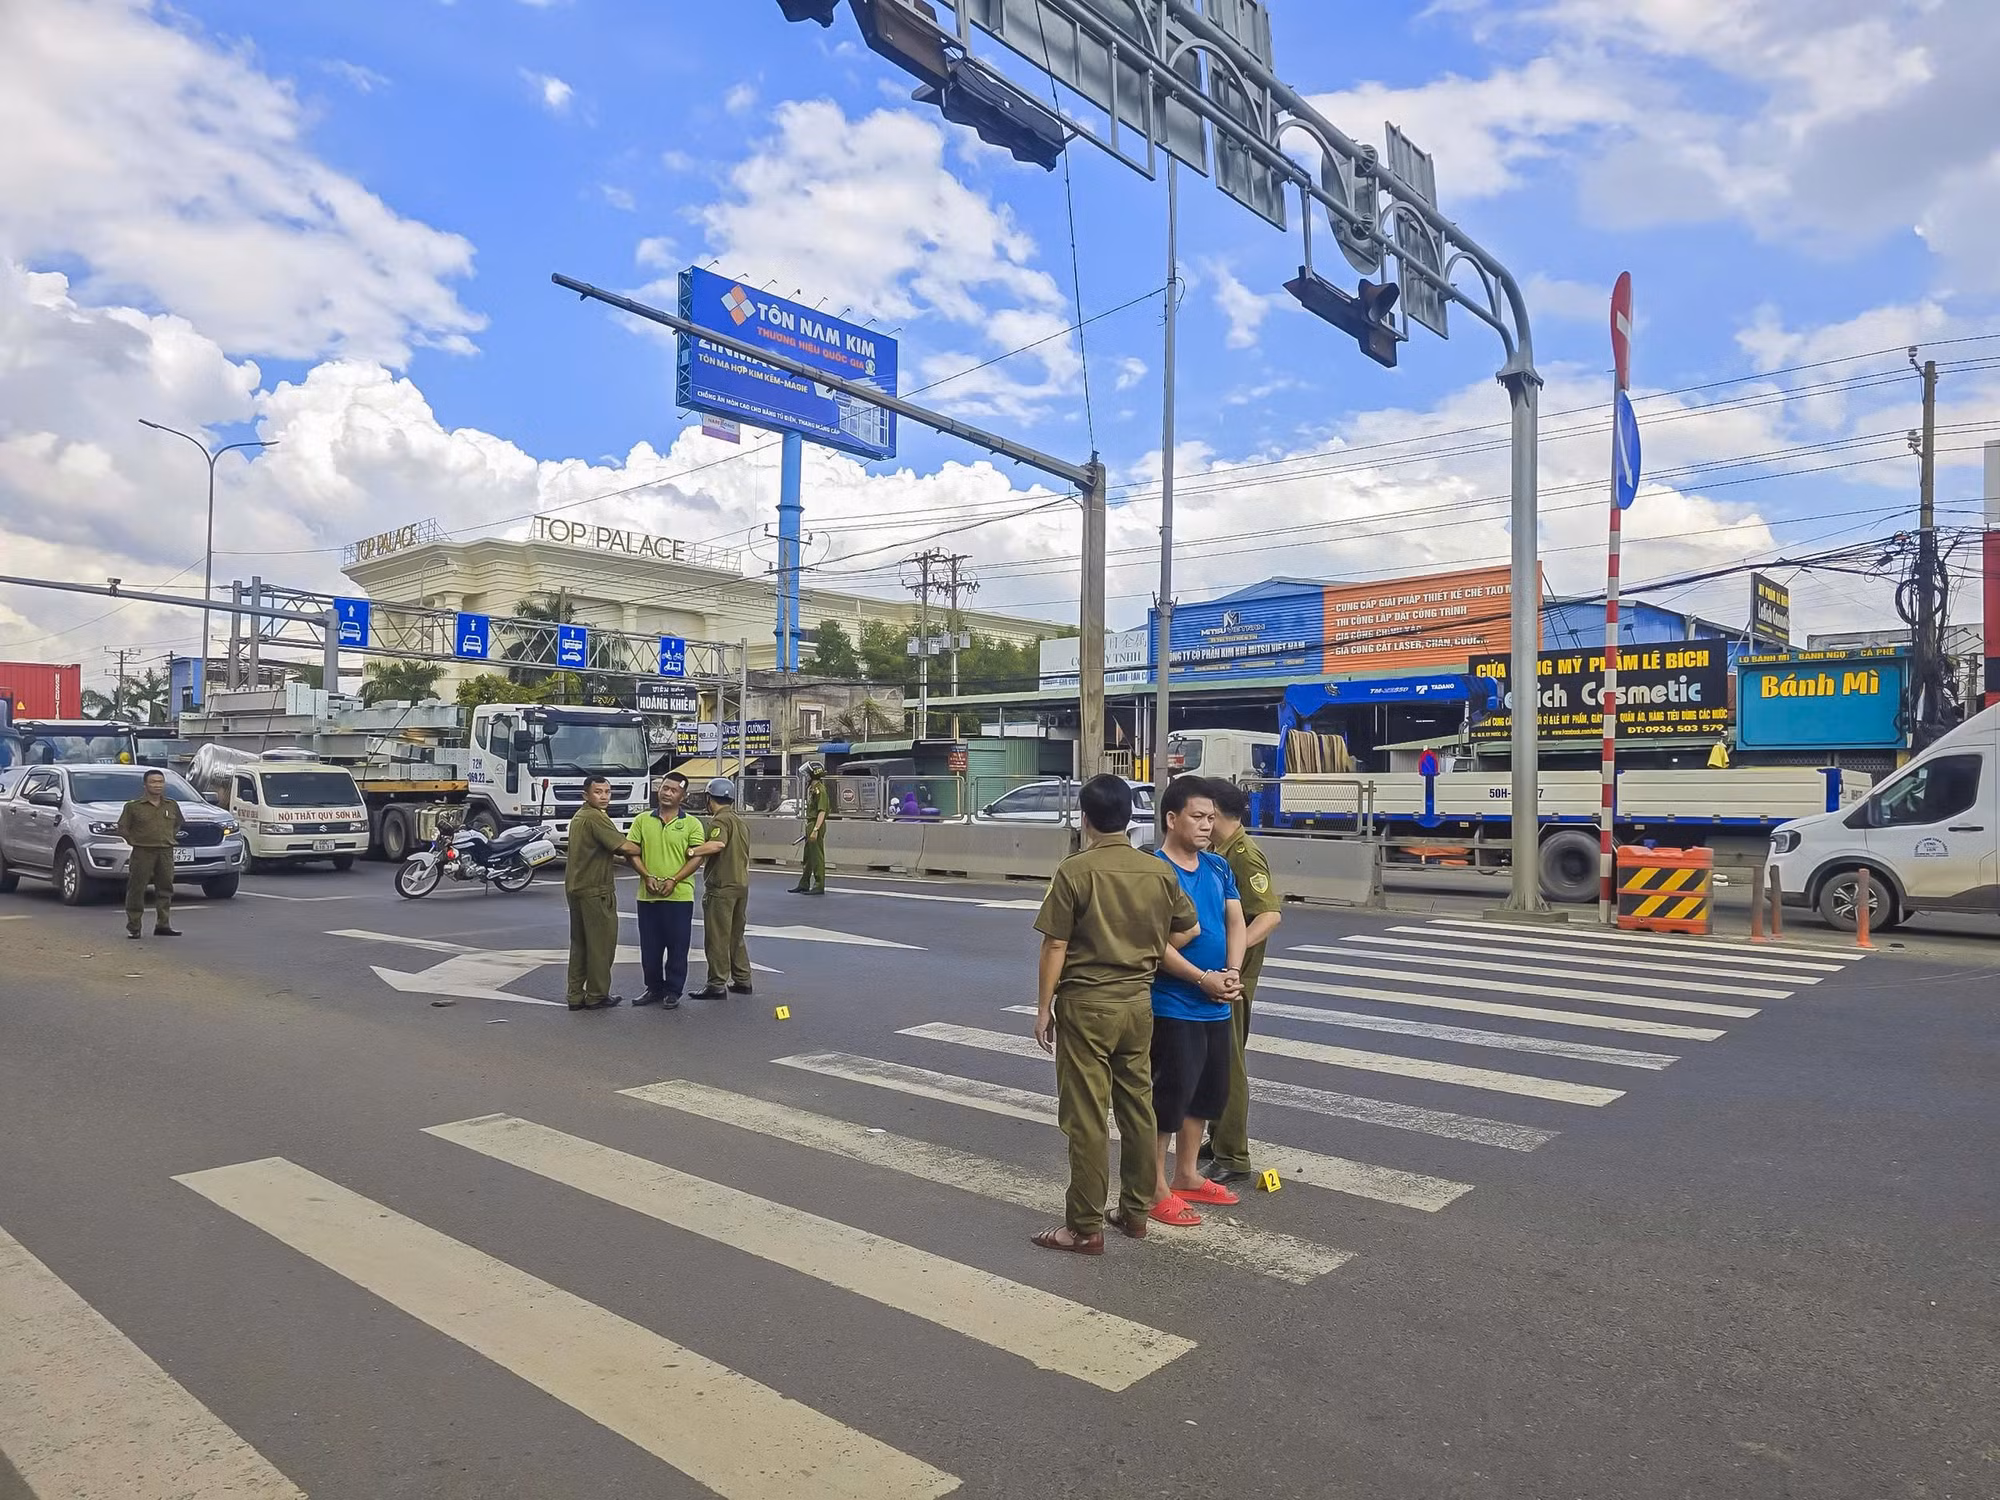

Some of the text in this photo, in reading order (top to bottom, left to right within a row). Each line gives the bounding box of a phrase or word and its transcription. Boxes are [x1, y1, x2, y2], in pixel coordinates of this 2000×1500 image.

[757, 302, 876, 359] TÔN NAM KIM
[698, 353, 715, 365] TÔN
[748, 369, 763, 380] KIM
[356, 523, 417, 562] TOP PALACE
[534, 515, 685, 562] TOP PALACE
[1336, 601, 1359, 612] CUNG
[1360, 597, 1377, 610] CẤP
[1397, 593, 1420, 606] PHÁP
[1423, 589, 1448, 603] THIẾT
[1450, 586, 1463, 600] KẾ
[1465, 584, 1483, 598] CHẾ
[1485, 584, 1504, 598] TẠO
[1336, 617, 1350, 627] THI
[1350, 613, 1374, 626] CÔNG
[1412, 606, 1437, 620] CÔNG
[1439, 605, 1467, 617] TRÌNH
[1168, 649, 1182, 662] ÔNG
[1476, 658, 1507, 679] CỬA
[1558, 655, 1582, 674] MỸ
[1642, 650, 1662, 670] LÊ
[1665, 648, 1709, 669] BÍCH
[1761, 669, 1879, 698] Bánh Mì
[640, 695, 696, 712] HOÀNG KHIÊM
[766, 723, 770, 733] 2
[1677, 724, 1699, 732] 503
[1702, 723, 1724, 732] 579
[472, 758, 483, 769] 72H
[278, 810, 293, 821] NỘI
[294, 809, 317, 820] THẤT
[335, 810, 350, 820] SƠN
[1268, 1173, 1277, 1187] 2
